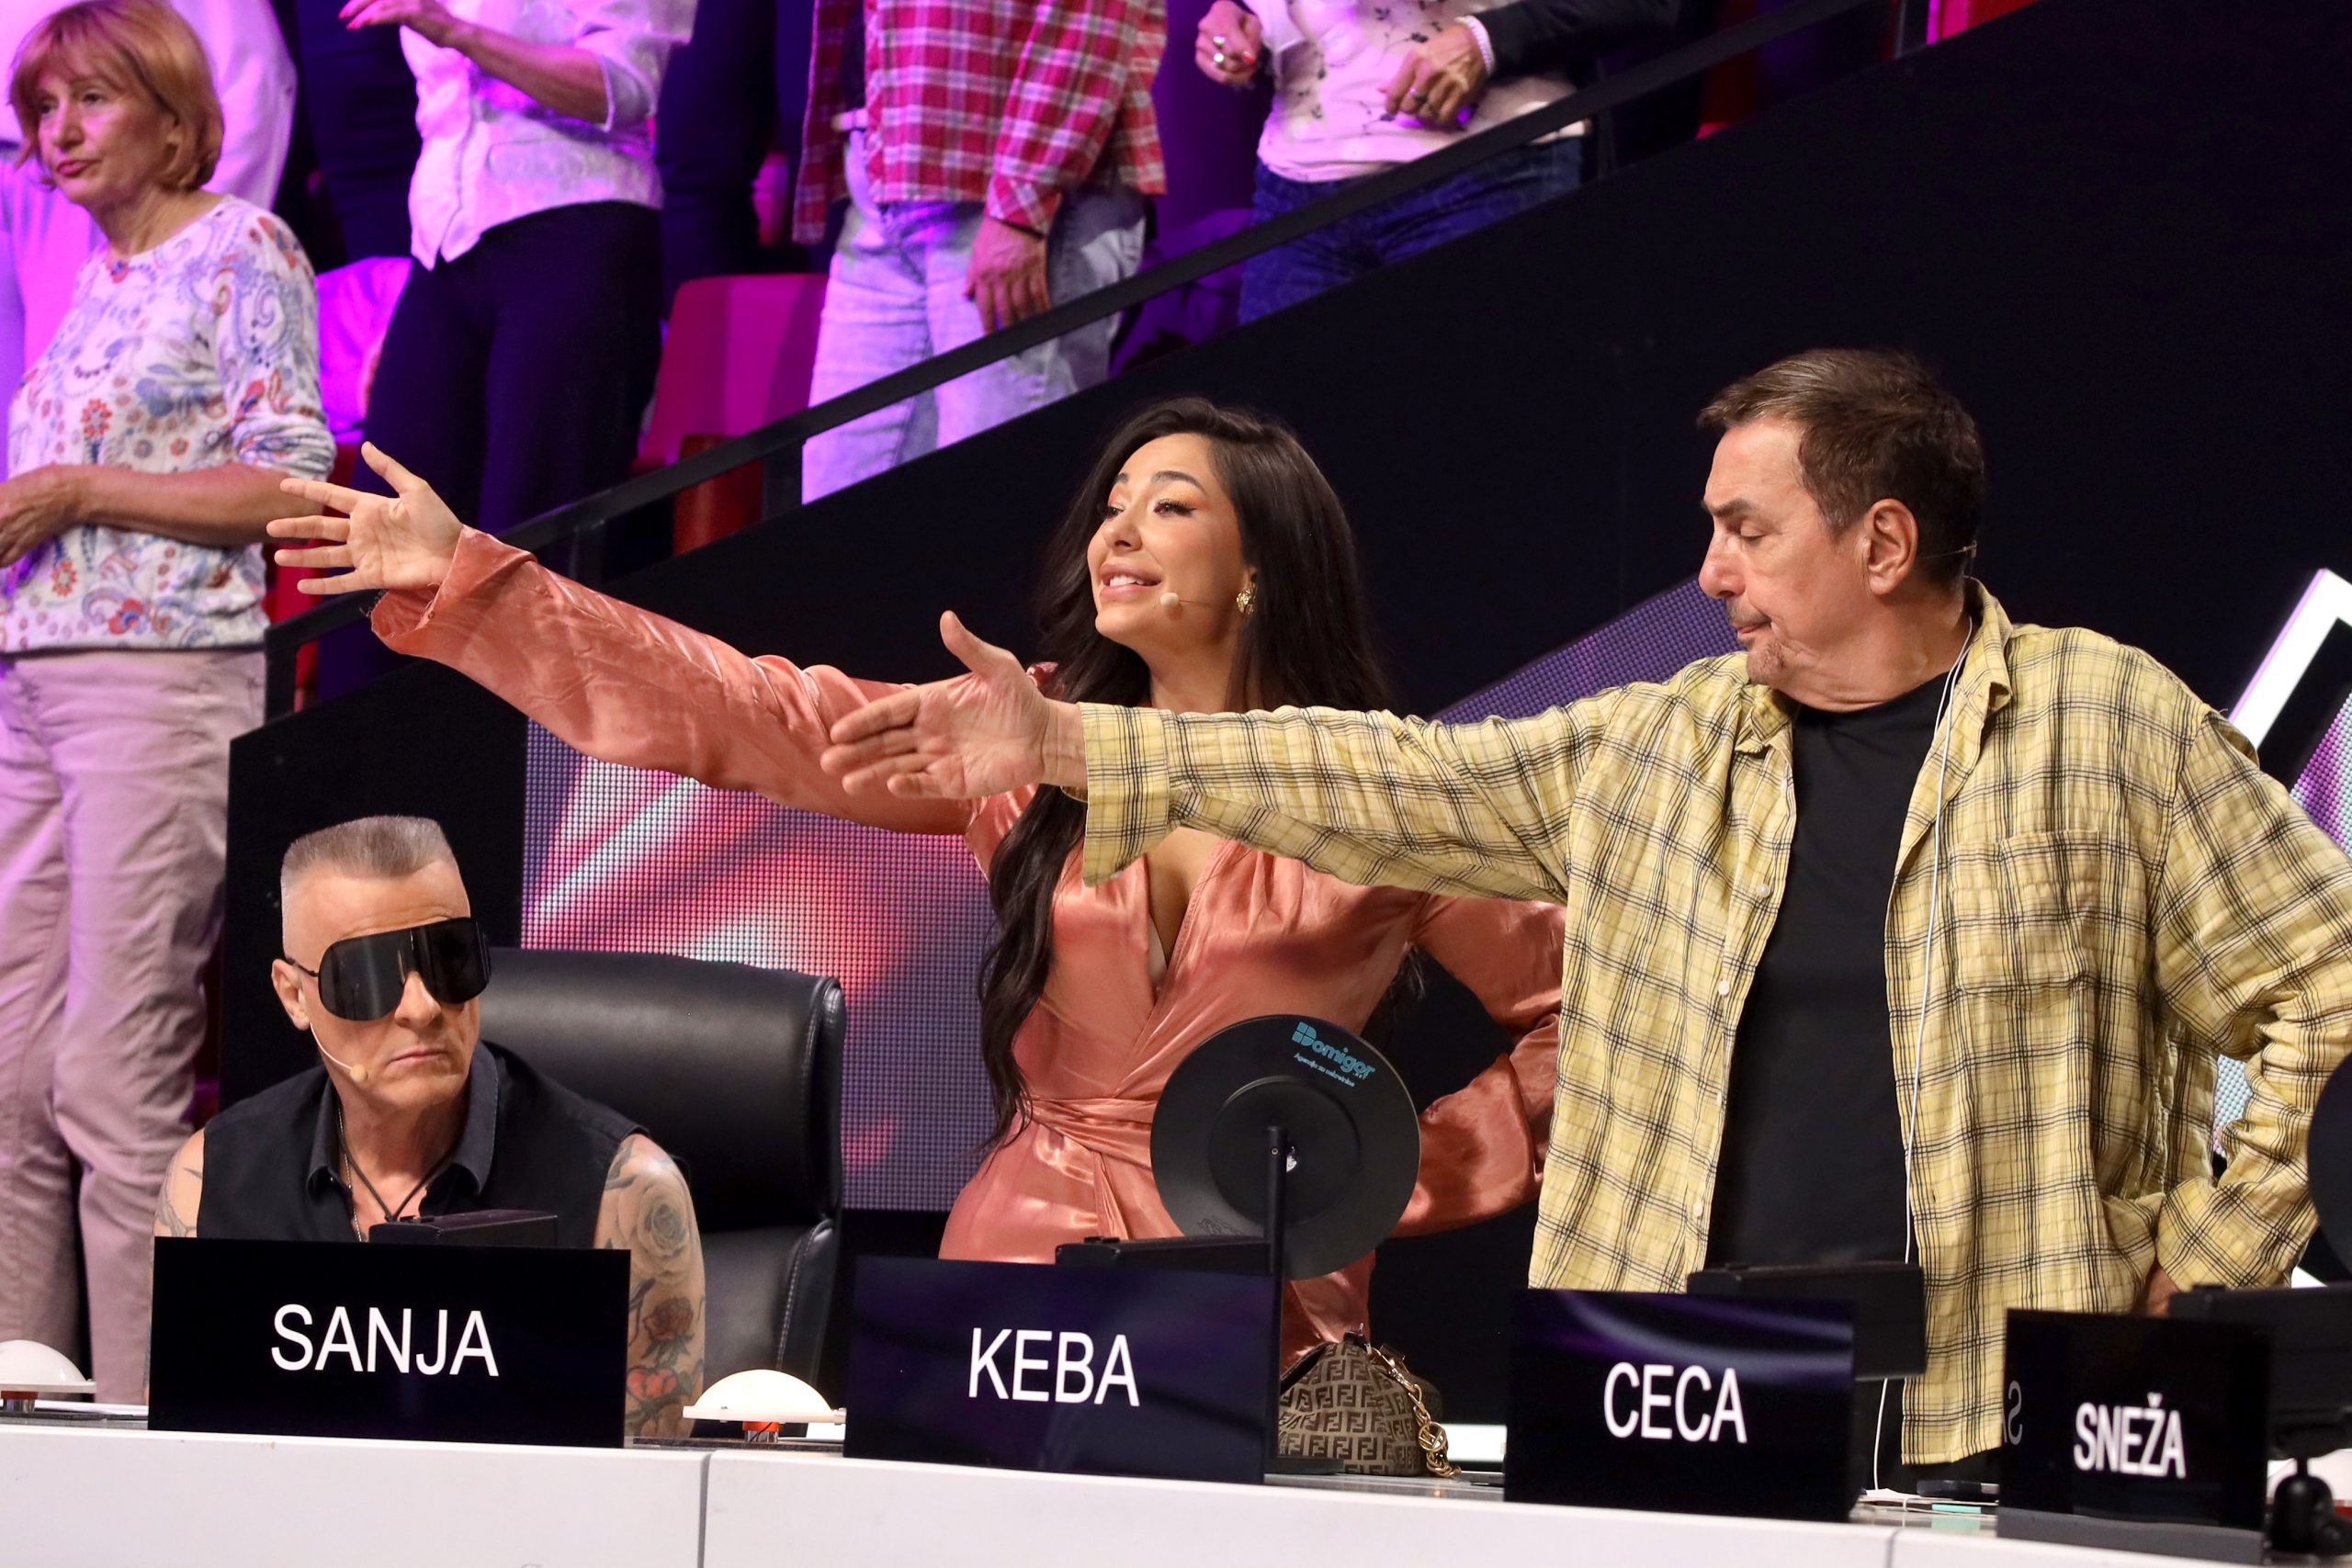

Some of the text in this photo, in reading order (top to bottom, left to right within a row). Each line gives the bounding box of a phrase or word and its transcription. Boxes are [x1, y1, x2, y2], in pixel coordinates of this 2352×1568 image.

[1292, 1021, 1376, 1077] Domigor
[271, 1303, 500, 1377] SANJA
[968, 1327, 1140, 1407] KEBA
[1603, 1361, 1747, 1444] CECA
[2074, 1392, 2186, 1479] SNEŽA
